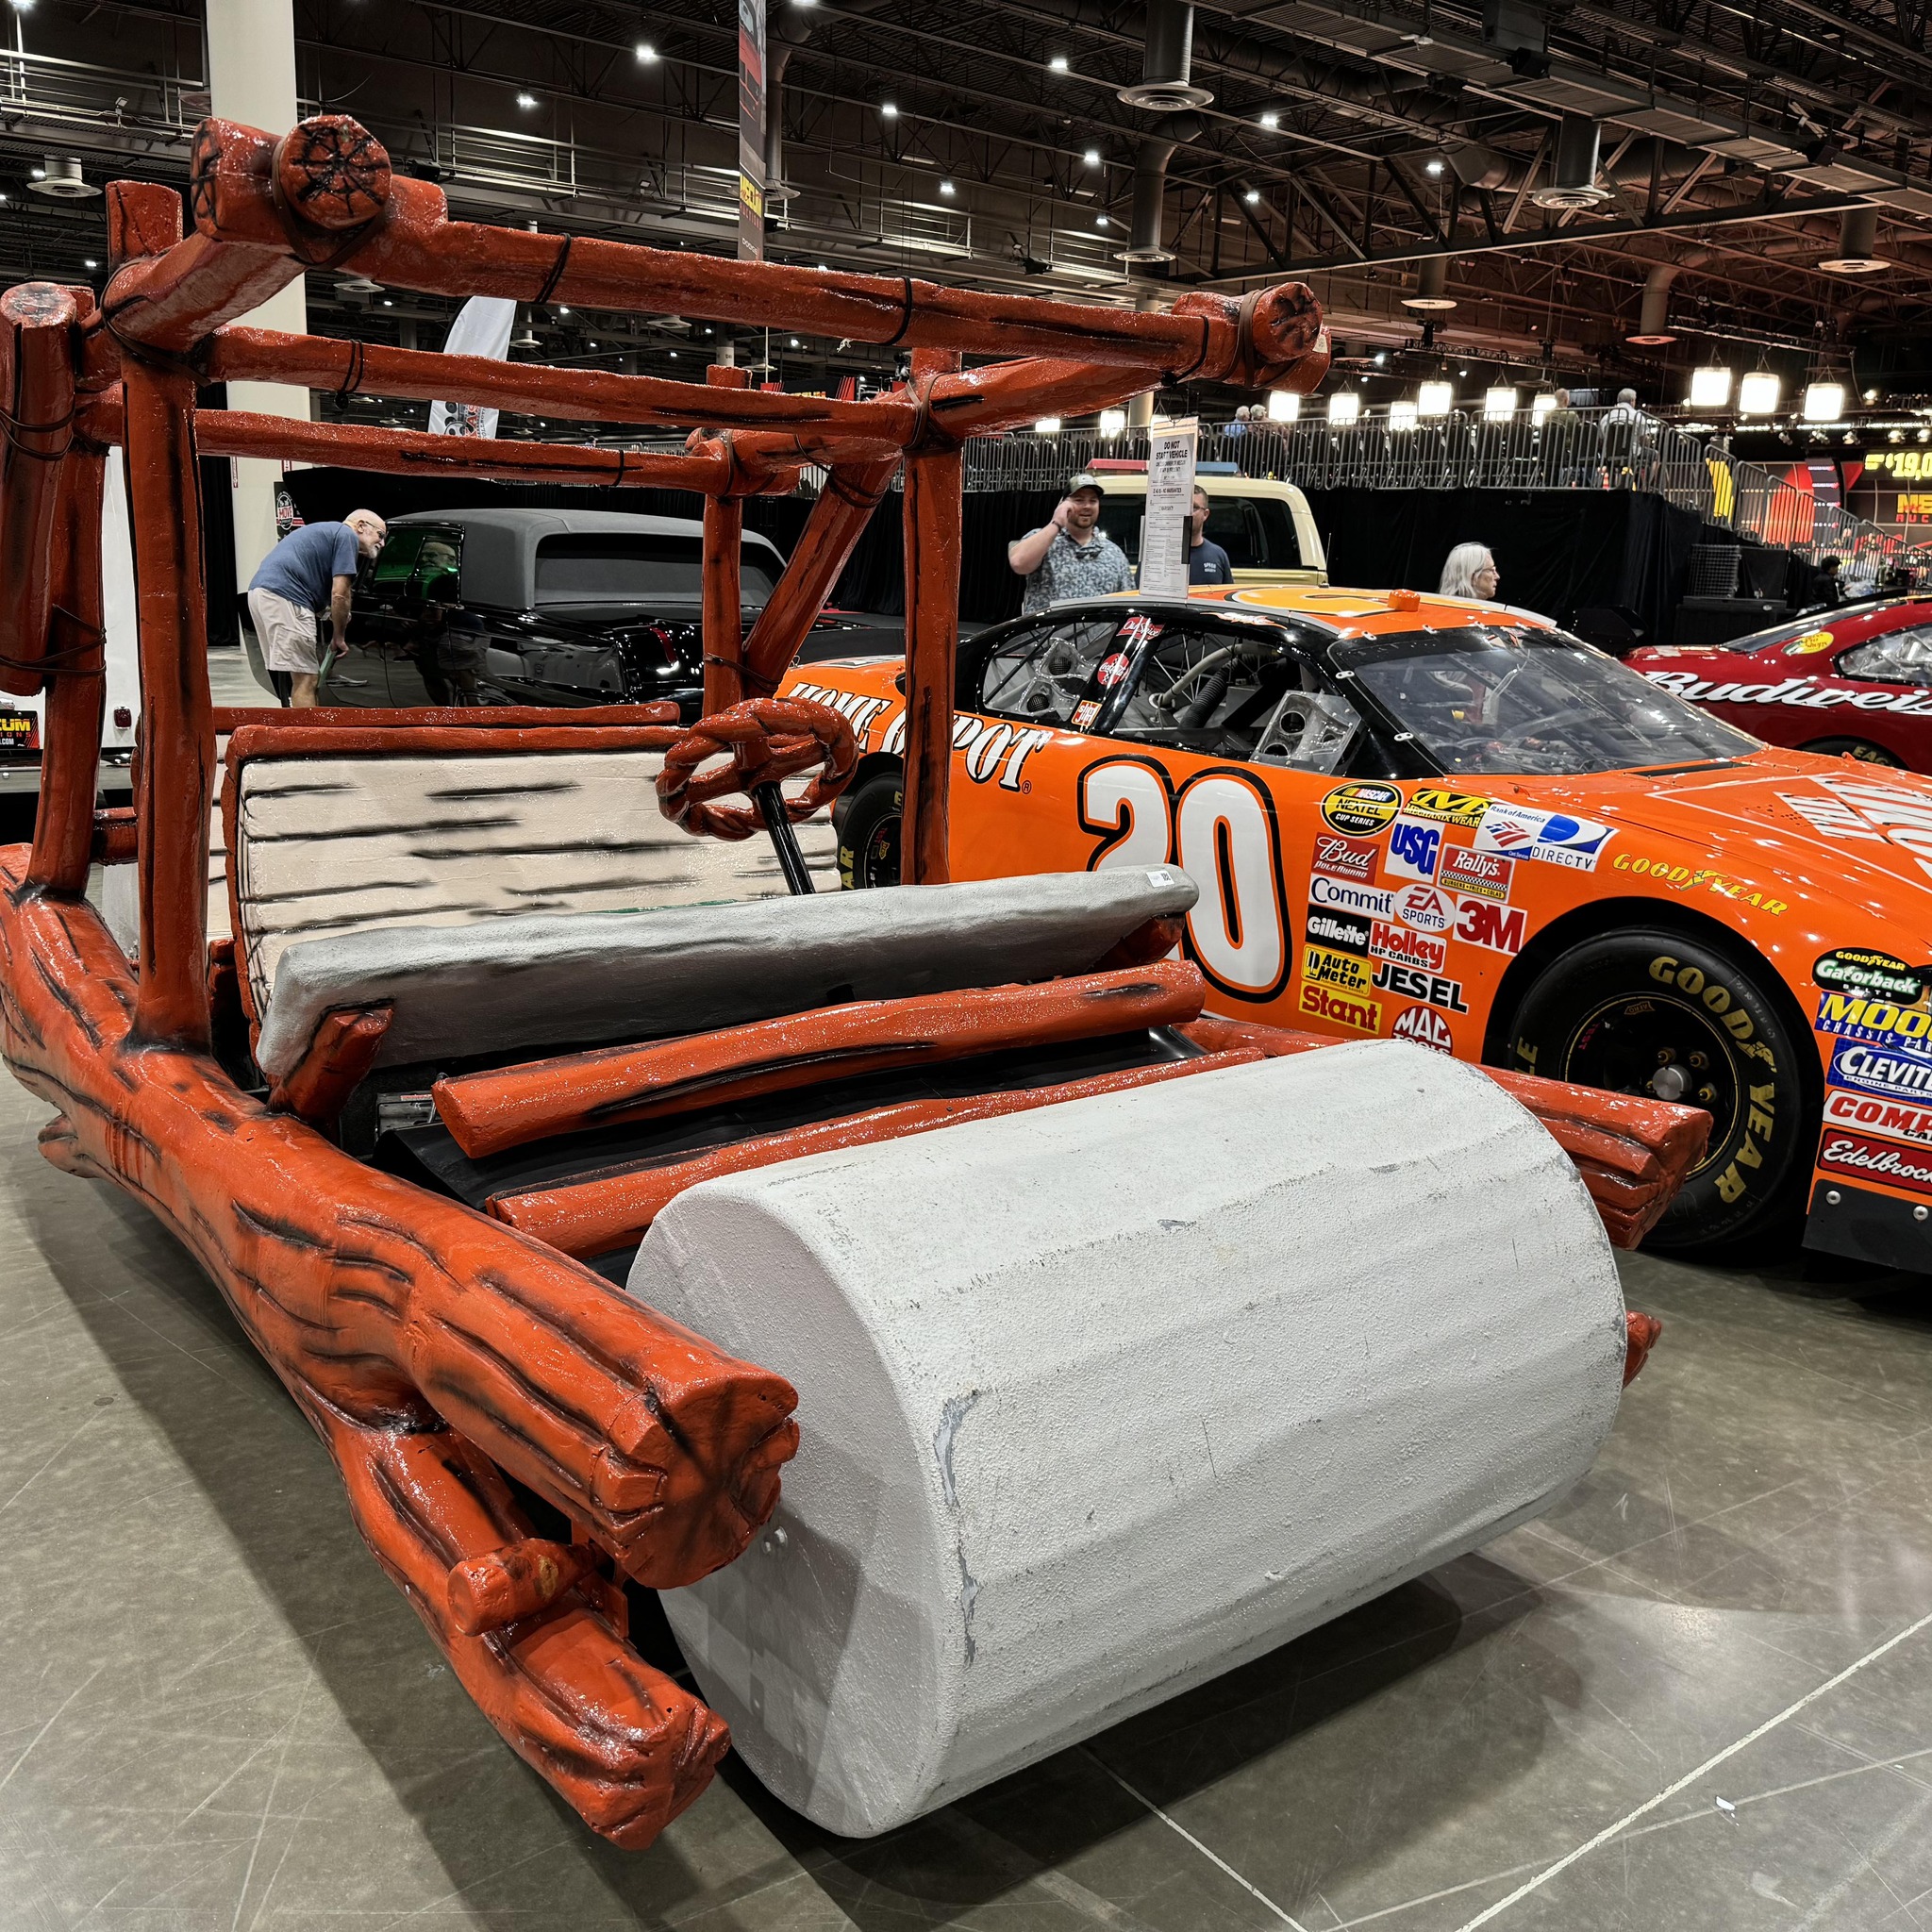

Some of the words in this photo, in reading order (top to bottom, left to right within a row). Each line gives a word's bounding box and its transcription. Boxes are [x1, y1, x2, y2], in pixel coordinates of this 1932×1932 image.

[741, 237, 758, 256] DODGE
[1169, 449, 1188, 459] VEHICLE
[1171, 440, 1180, 449] NOT
[0, 718, 31, 731] UM
[1335, 798, 1381, 816] NEXTEL
[1355, 788, 1391, 802] NASCAR
[1335, 813, 1351, 822] CUP
[1350, 816, 1375, 826] SERIES
[1403, 803, 1451, 823] MECHANIX
[1451, 814, 1480, 828] WEAR
[1491, 806, 1507, 815] Bank
[1507, 809, 1517, 818] of
[1516, 811, 1546, 824] America
[1317, 836, 1376, 866] Bud
[1391, 823, 1440, 875] USG
[1532, 846, 1593, 870] DIRECTV
[1077, 754, 1292, 1004] 20
[1311, 877, 1391, 914] Commit
[1405, 886, 1444, 916] EA
[1487, 890, 1503, 898] COLAS
[1402, 908, 1446, 929] SPORTS
[1457, 900, 1525, 954] 3M
[1307, 916, 1367, 946] Gillette
[1371, 945, 1386, 957] HP
[1389, 950, 1428, 969] CARBS
[1372, 923, 1444, 971] Holley
[1323, 954, 1359, 974] Auto
[1836, 951, 1906, 971] GOODYEAR
[1319, 964, 1367, 990] Meter
[1372, 963, 1469, 1014] JESEL
[1815, 958, 1922, 996] Gatorback
[1842, 983, 1892, 998] BELTS
[1301, 985, 1378, 1032] Stant
[1819, 993, 1932, 1042] MOO
[1394, 1007, 1452, 1048] MAC
[1822, 1019, 1894, 1044] CHASSIS
[1845, 1075, 1890, 1088] ENGINE
[1903, 1128, 1932, 1141] CA
[1823, 1140, 1932, 1183] Edelbroc
